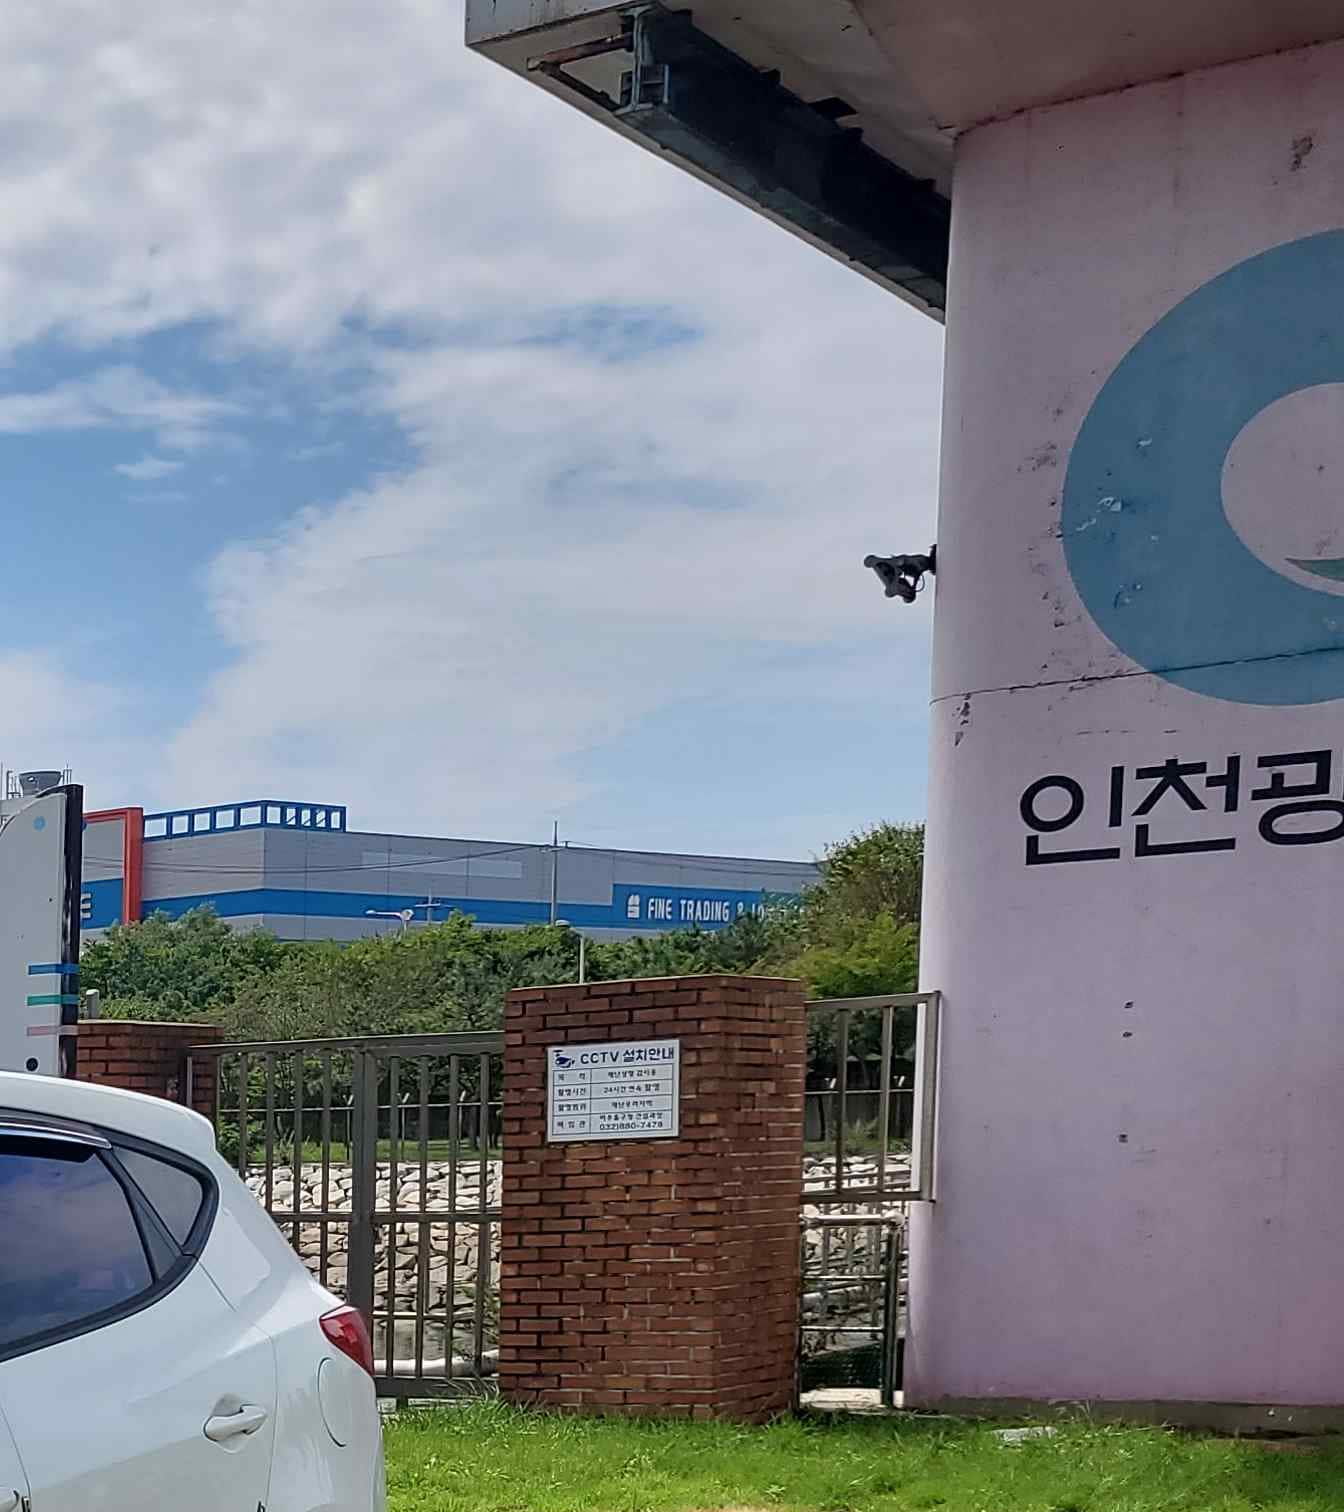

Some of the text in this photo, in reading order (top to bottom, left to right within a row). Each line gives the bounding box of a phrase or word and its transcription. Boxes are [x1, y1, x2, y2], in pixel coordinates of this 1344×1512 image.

[648, 897, 673, 921] FINE
[680, 898, 731, 922] TRADING
[580, 1047, 674, 1065] CCTV 설치안내
